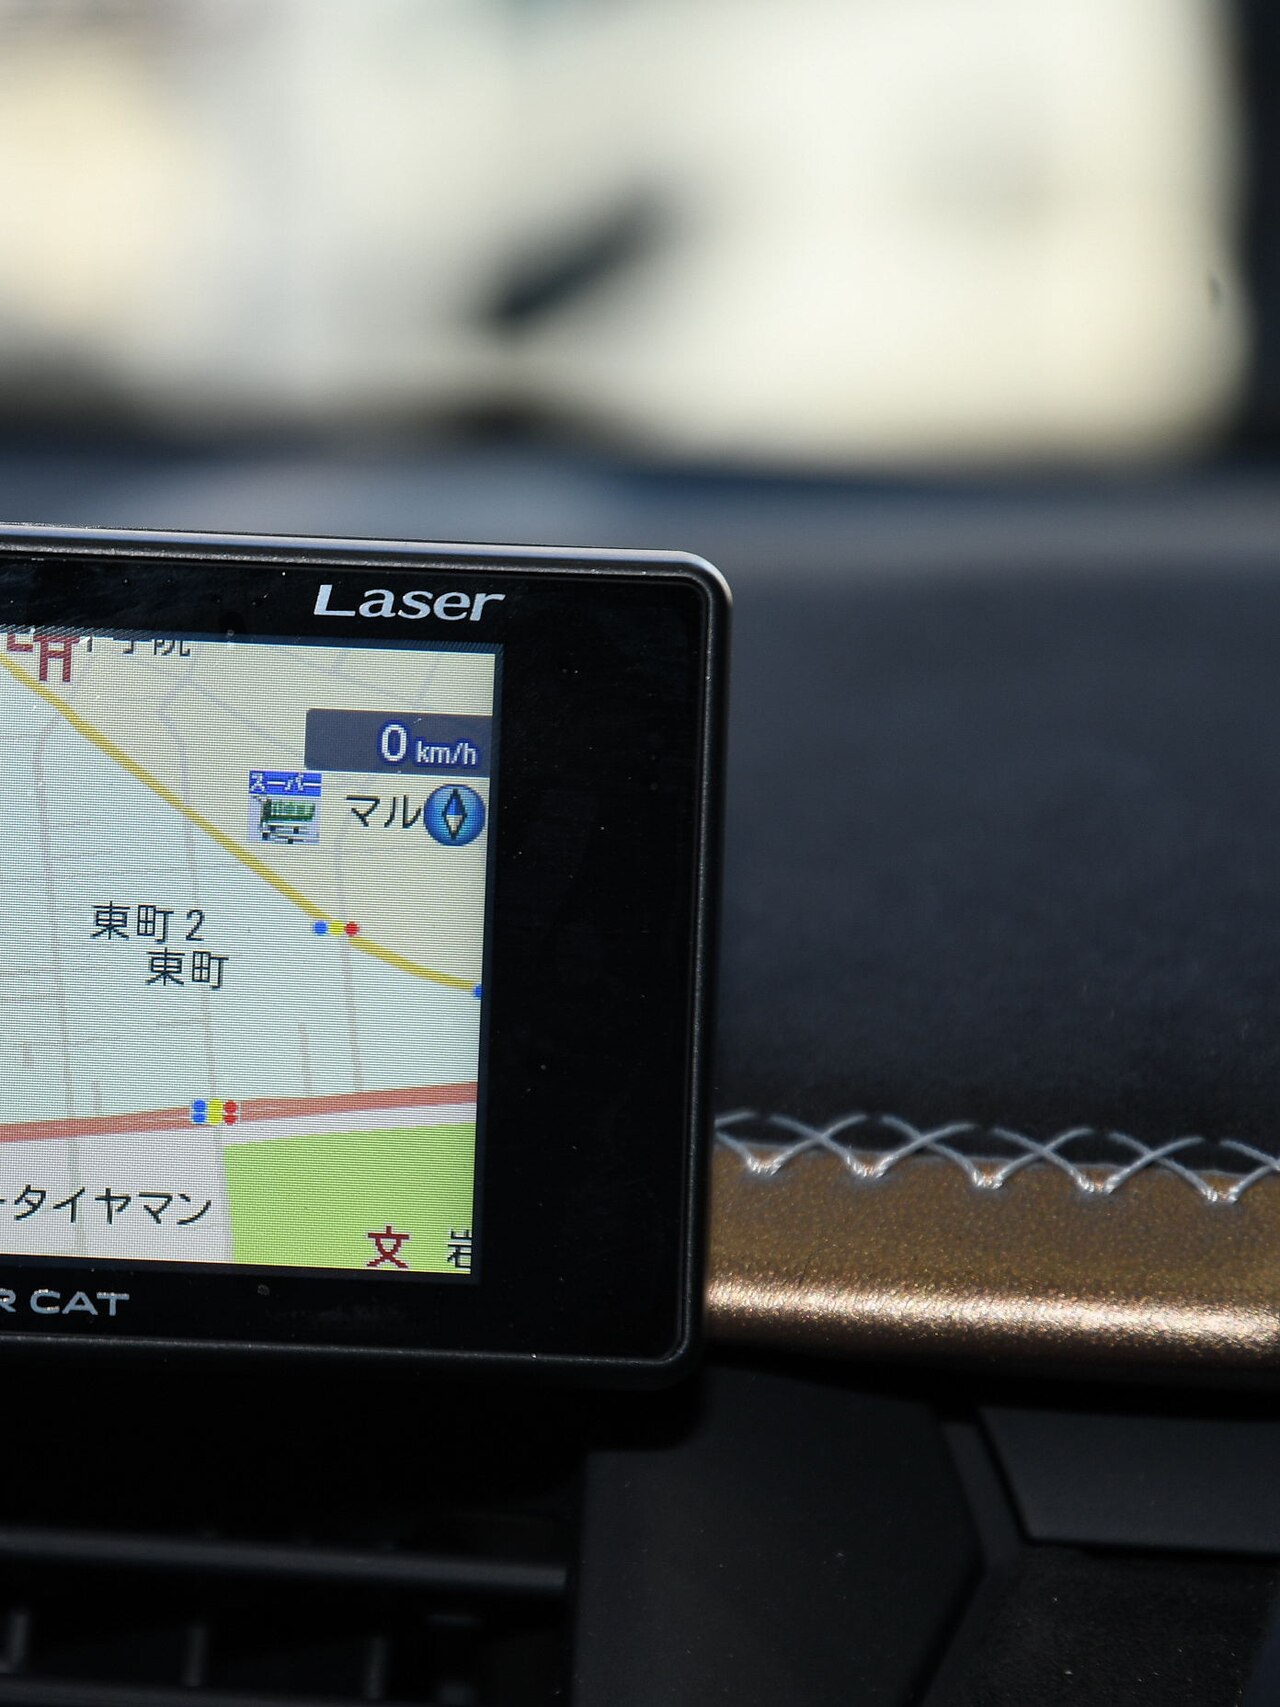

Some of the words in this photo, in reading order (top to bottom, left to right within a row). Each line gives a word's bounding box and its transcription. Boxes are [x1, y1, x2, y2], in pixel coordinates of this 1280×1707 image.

[313, 583, 507, 622] Laser
[379, 723, 409, 765] 0
[416, 739, 479, 767] km/h
[250, 773, 322, 793] スーパー
[345, 793, 423, 829] マル
[144, 946, 230, 991] 東町
[29, 1287, 131, 1317] CAT
